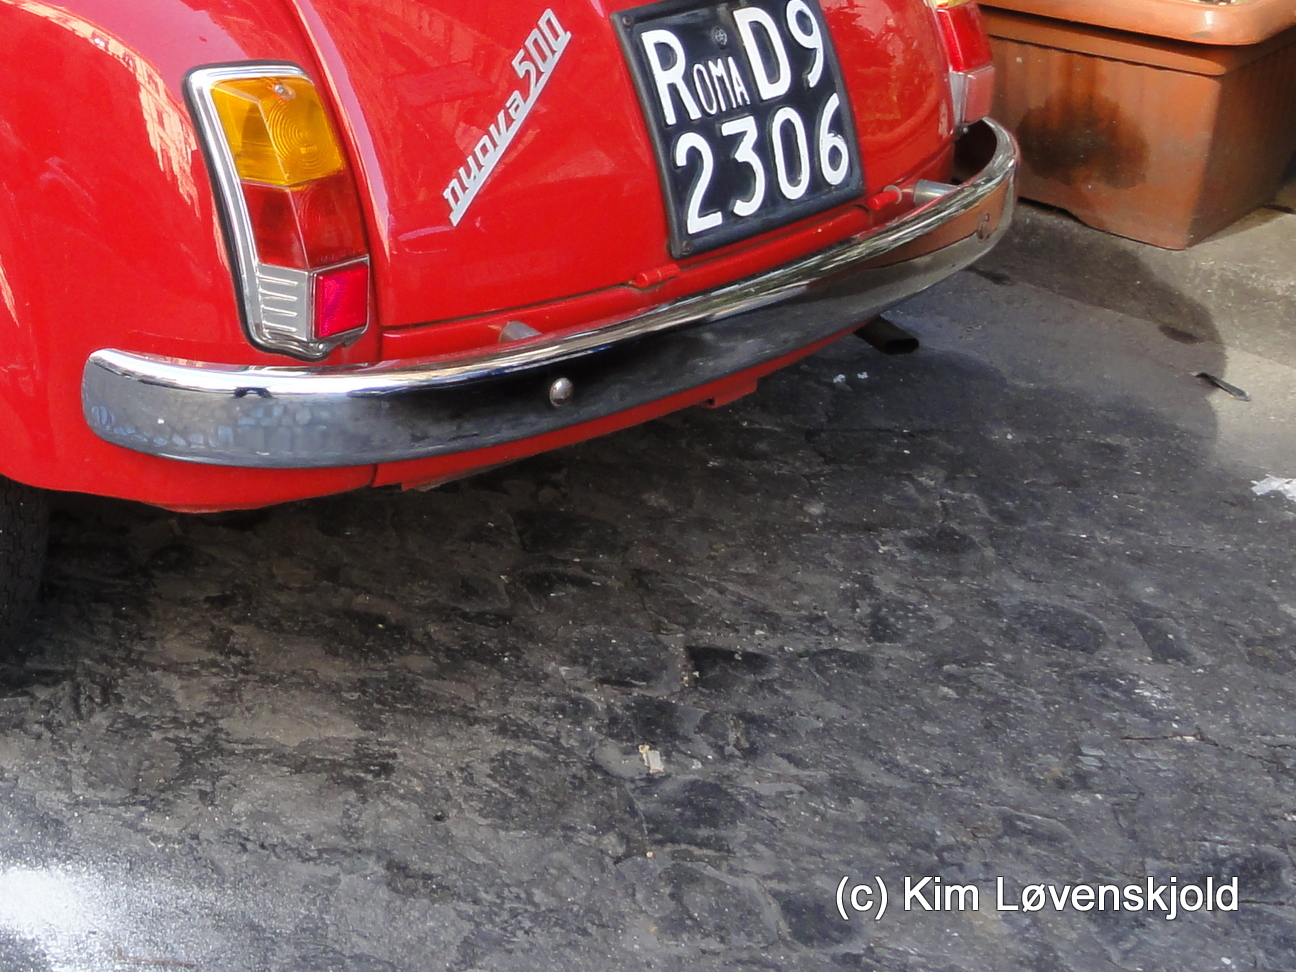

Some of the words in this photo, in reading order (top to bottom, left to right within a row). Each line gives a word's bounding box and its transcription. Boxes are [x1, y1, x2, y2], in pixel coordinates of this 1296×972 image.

[733, 0, 824, 89] D9
[442, 90, 527, 226] nuova
[511, 8, 572, 102] 500
[675, 92, 850, 235] 2306
